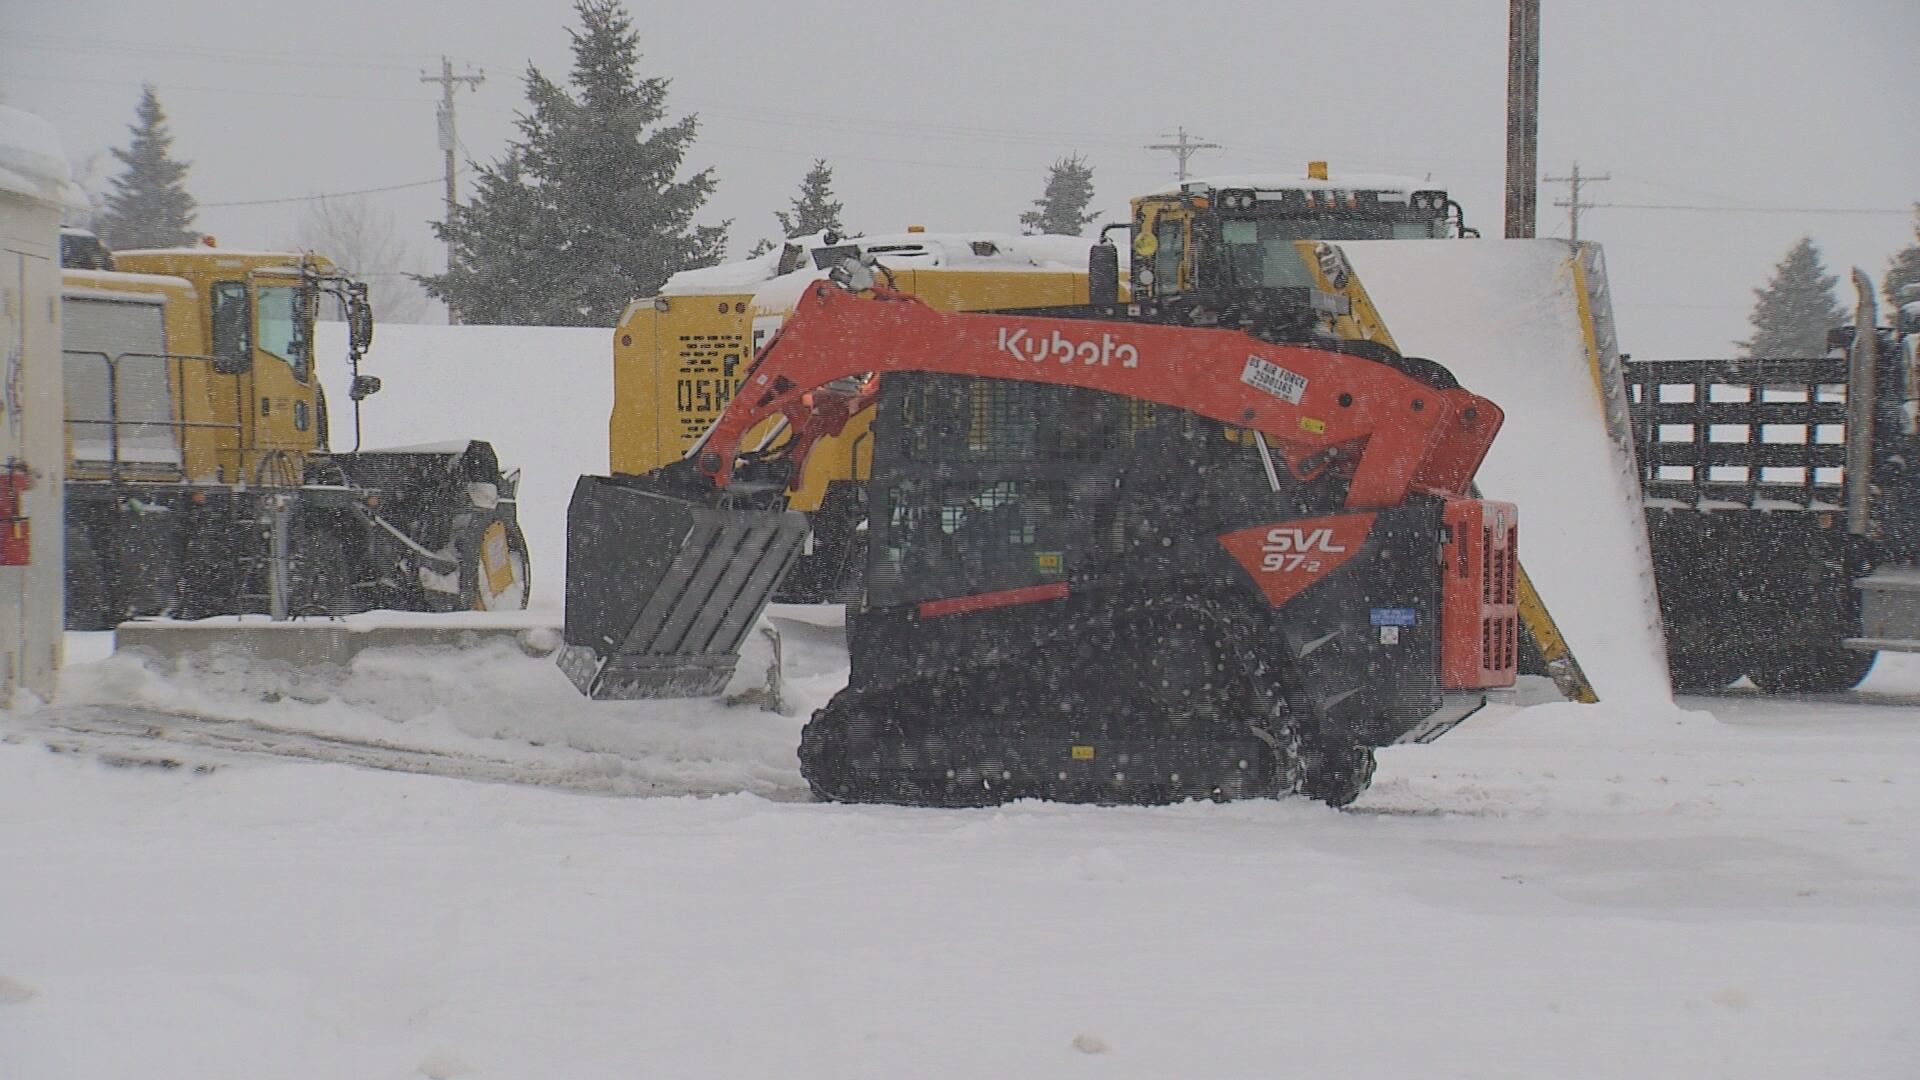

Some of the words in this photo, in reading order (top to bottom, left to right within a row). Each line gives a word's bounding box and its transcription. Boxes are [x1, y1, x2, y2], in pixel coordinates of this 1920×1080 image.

[998, 327, 1138, 368] Kubota
[1249, 358, 1261, 369] US
[1263, 363, 1278, 375] AIR
[1280, 369, 1305, 389] FORCE
[1262, 528, 1346, 552] SVL
[1261, 553, 1321, 572] 97-2
